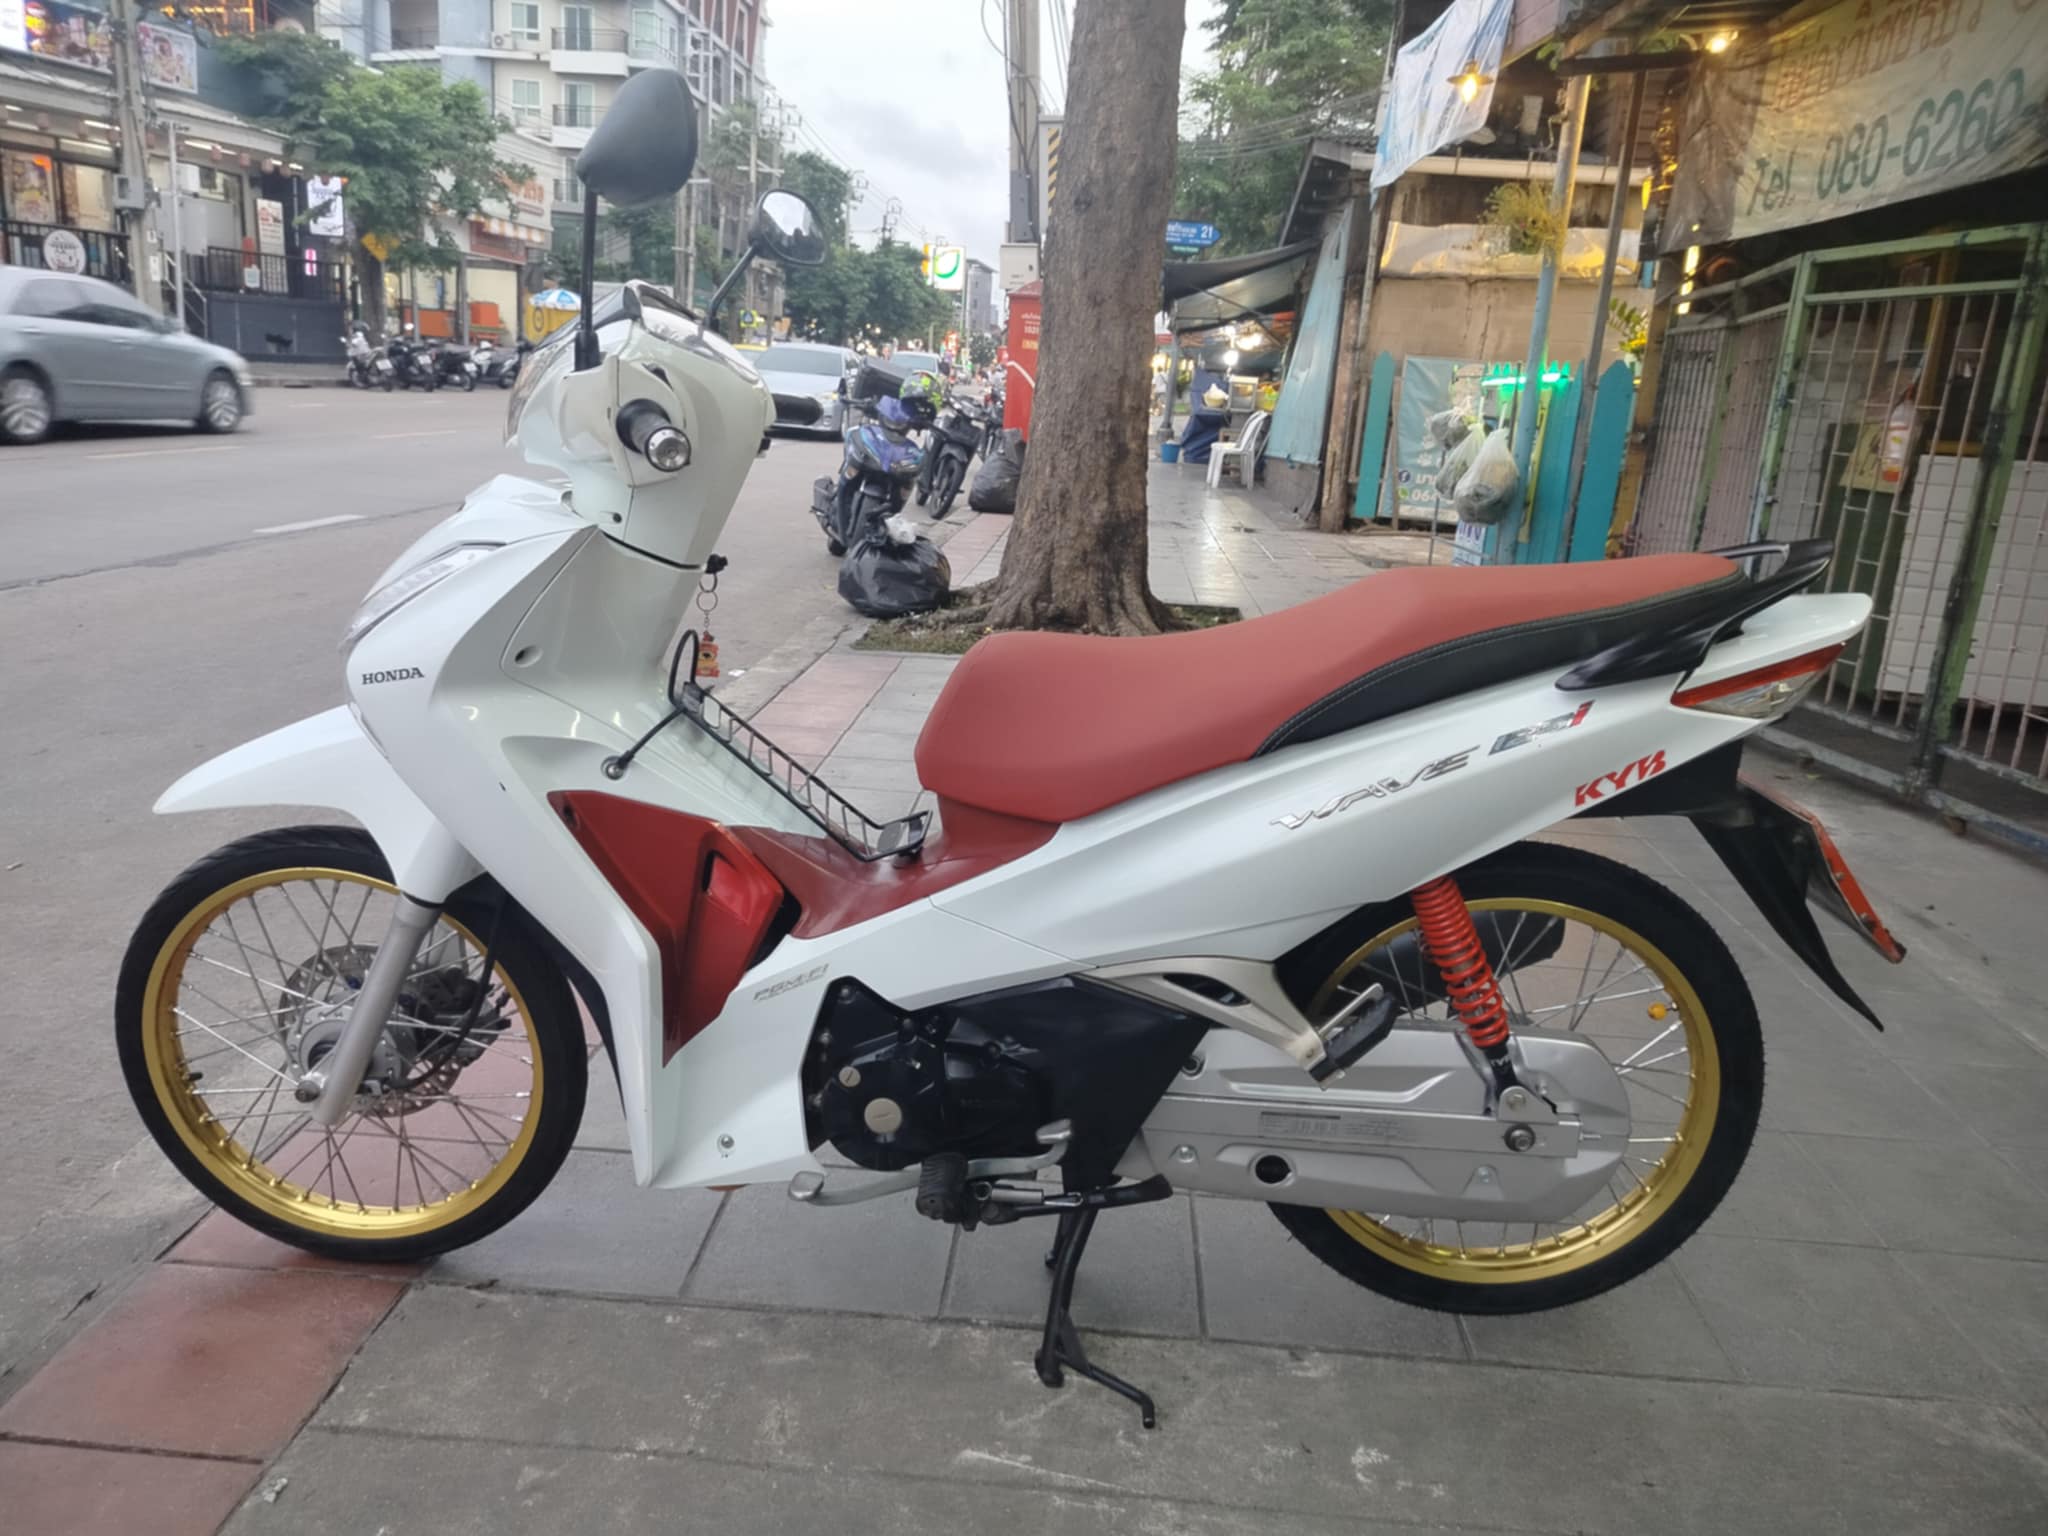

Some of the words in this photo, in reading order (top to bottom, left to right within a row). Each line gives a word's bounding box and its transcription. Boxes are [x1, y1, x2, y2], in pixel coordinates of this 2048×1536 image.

[1201, 224, 1214, 239] 21
[361, 667, 425, 685] HONDA
[1269, 744, 1480, 830] WAVE
[1574, 749, 1667, 807] KYB
